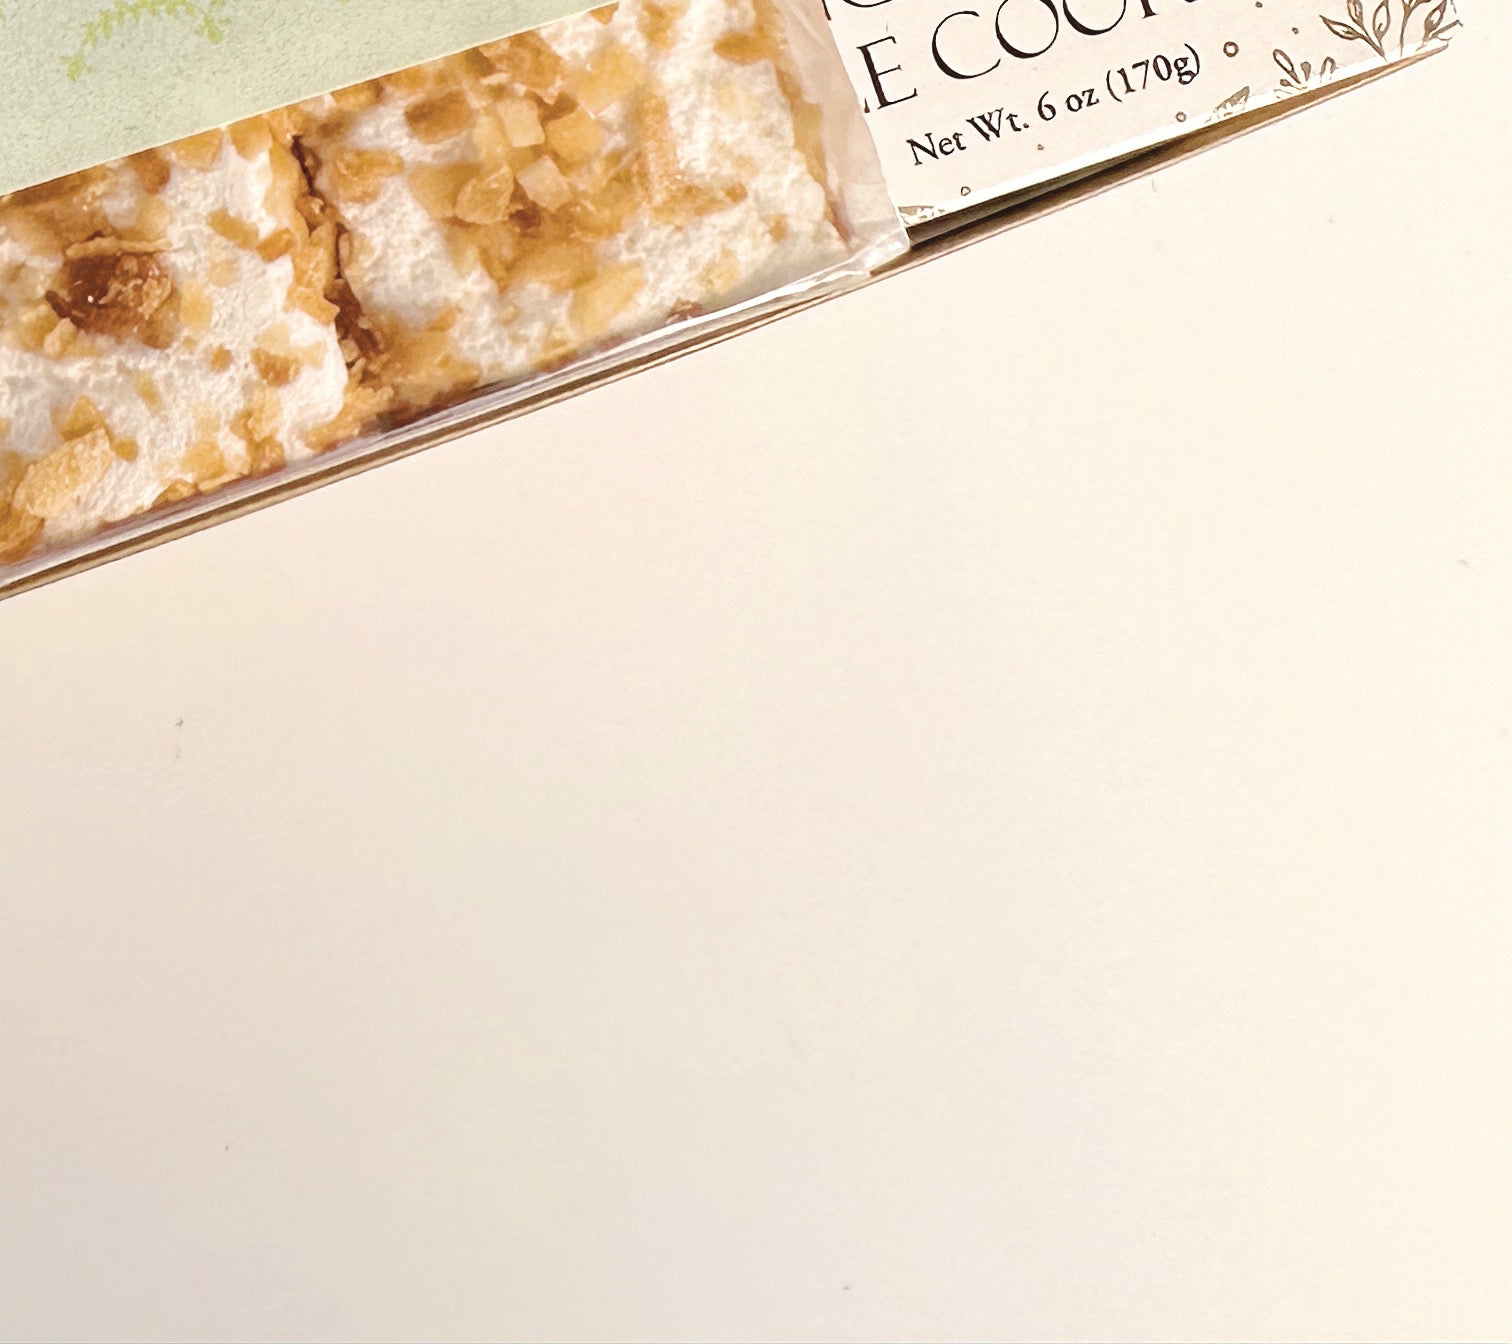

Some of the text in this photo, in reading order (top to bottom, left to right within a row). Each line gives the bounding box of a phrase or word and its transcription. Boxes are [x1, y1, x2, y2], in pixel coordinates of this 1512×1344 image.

[905, 43, 1202, 166] Net Wt. 6 oz (170g)
